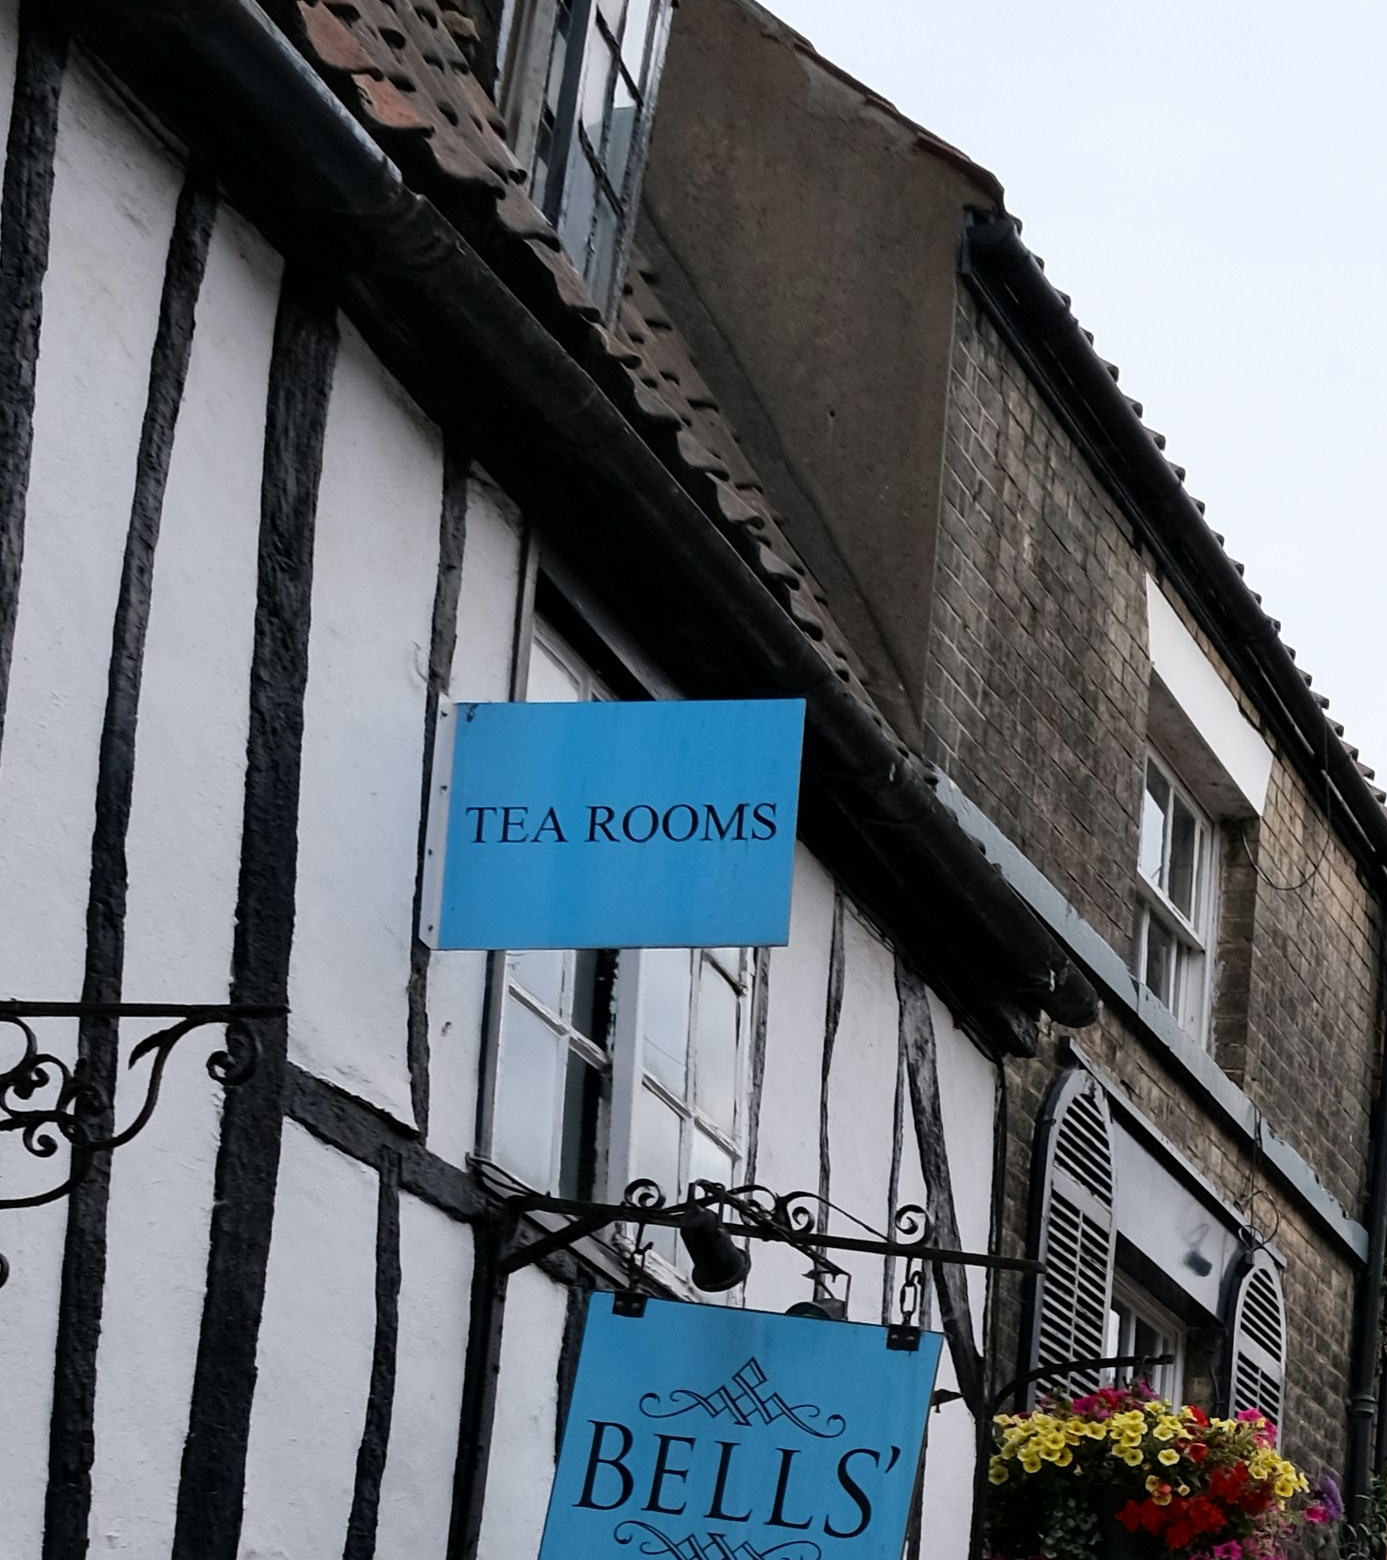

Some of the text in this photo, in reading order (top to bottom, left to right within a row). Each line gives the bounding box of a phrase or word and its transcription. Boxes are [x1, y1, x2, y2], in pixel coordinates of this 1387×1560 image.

[465, 802, 778, 844] TEA ROOMS
[572, 1418, 902, 1539] BELLS'
